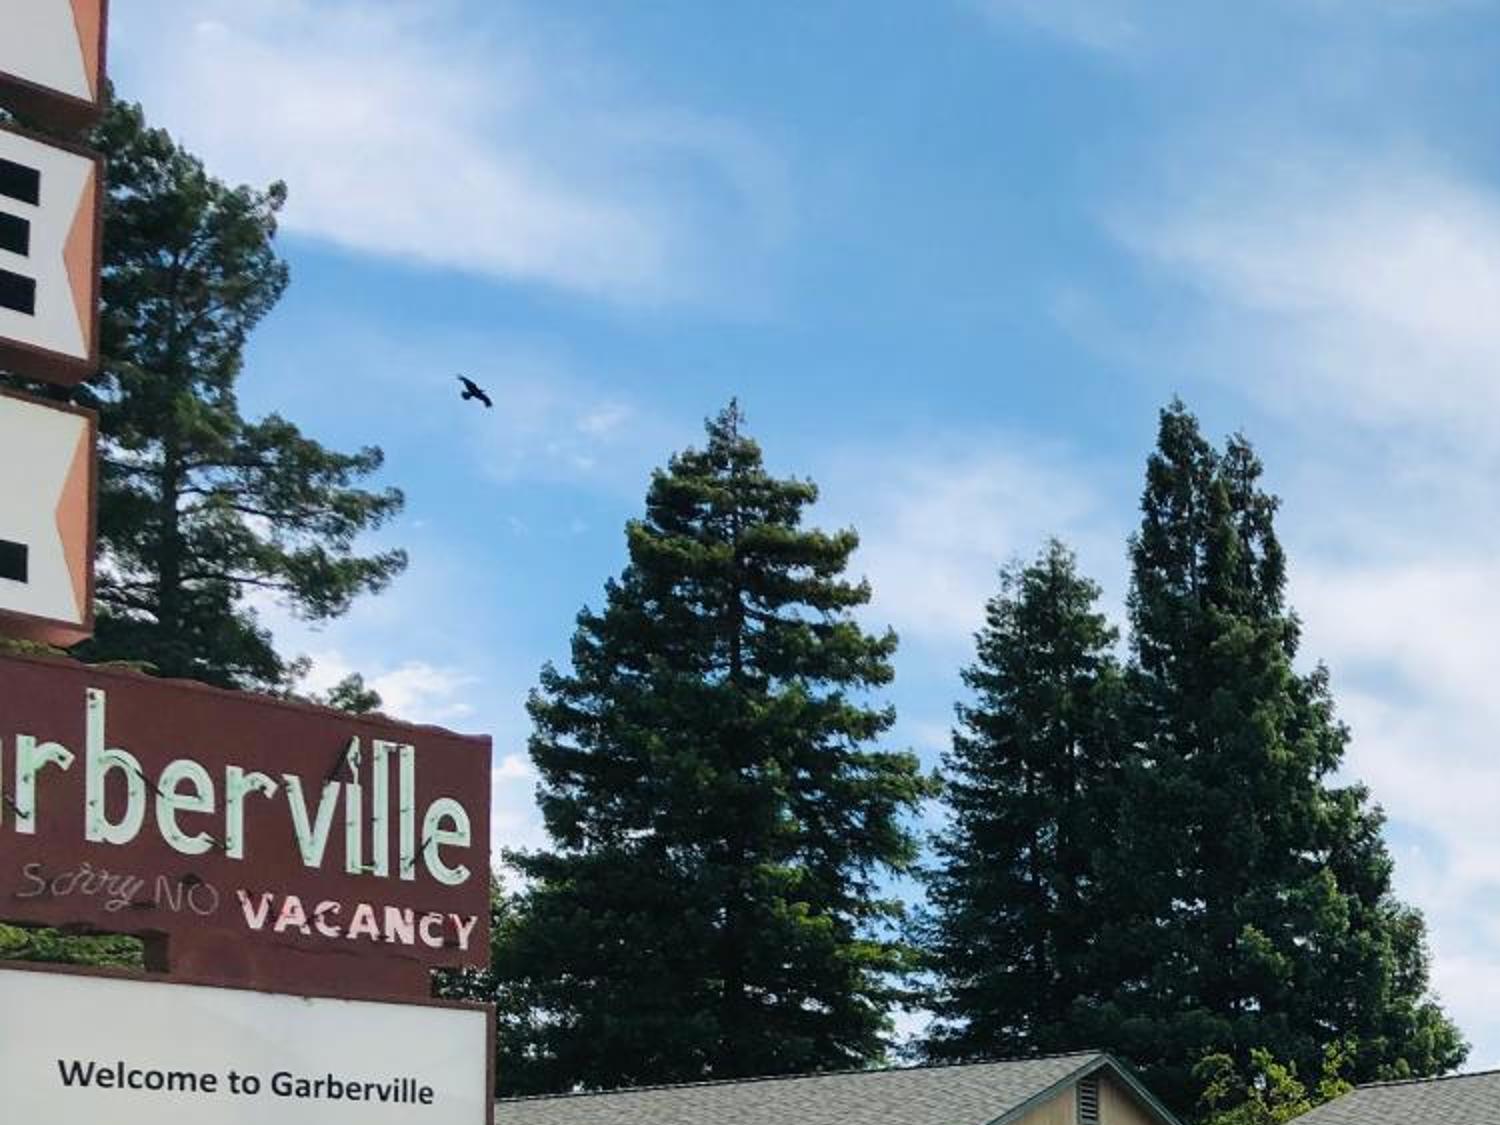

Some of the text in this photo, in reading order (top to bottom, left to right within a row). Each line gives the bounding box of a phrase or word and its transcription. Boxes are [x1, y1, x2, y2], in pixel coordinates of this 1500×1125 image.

[0, 687, 472, 886] rberville
[155, 875, 219, 915] NO
[236, 889, 479, 951] VACANCY
[58, 1060, 434, 1105] Welcome to Garberville
